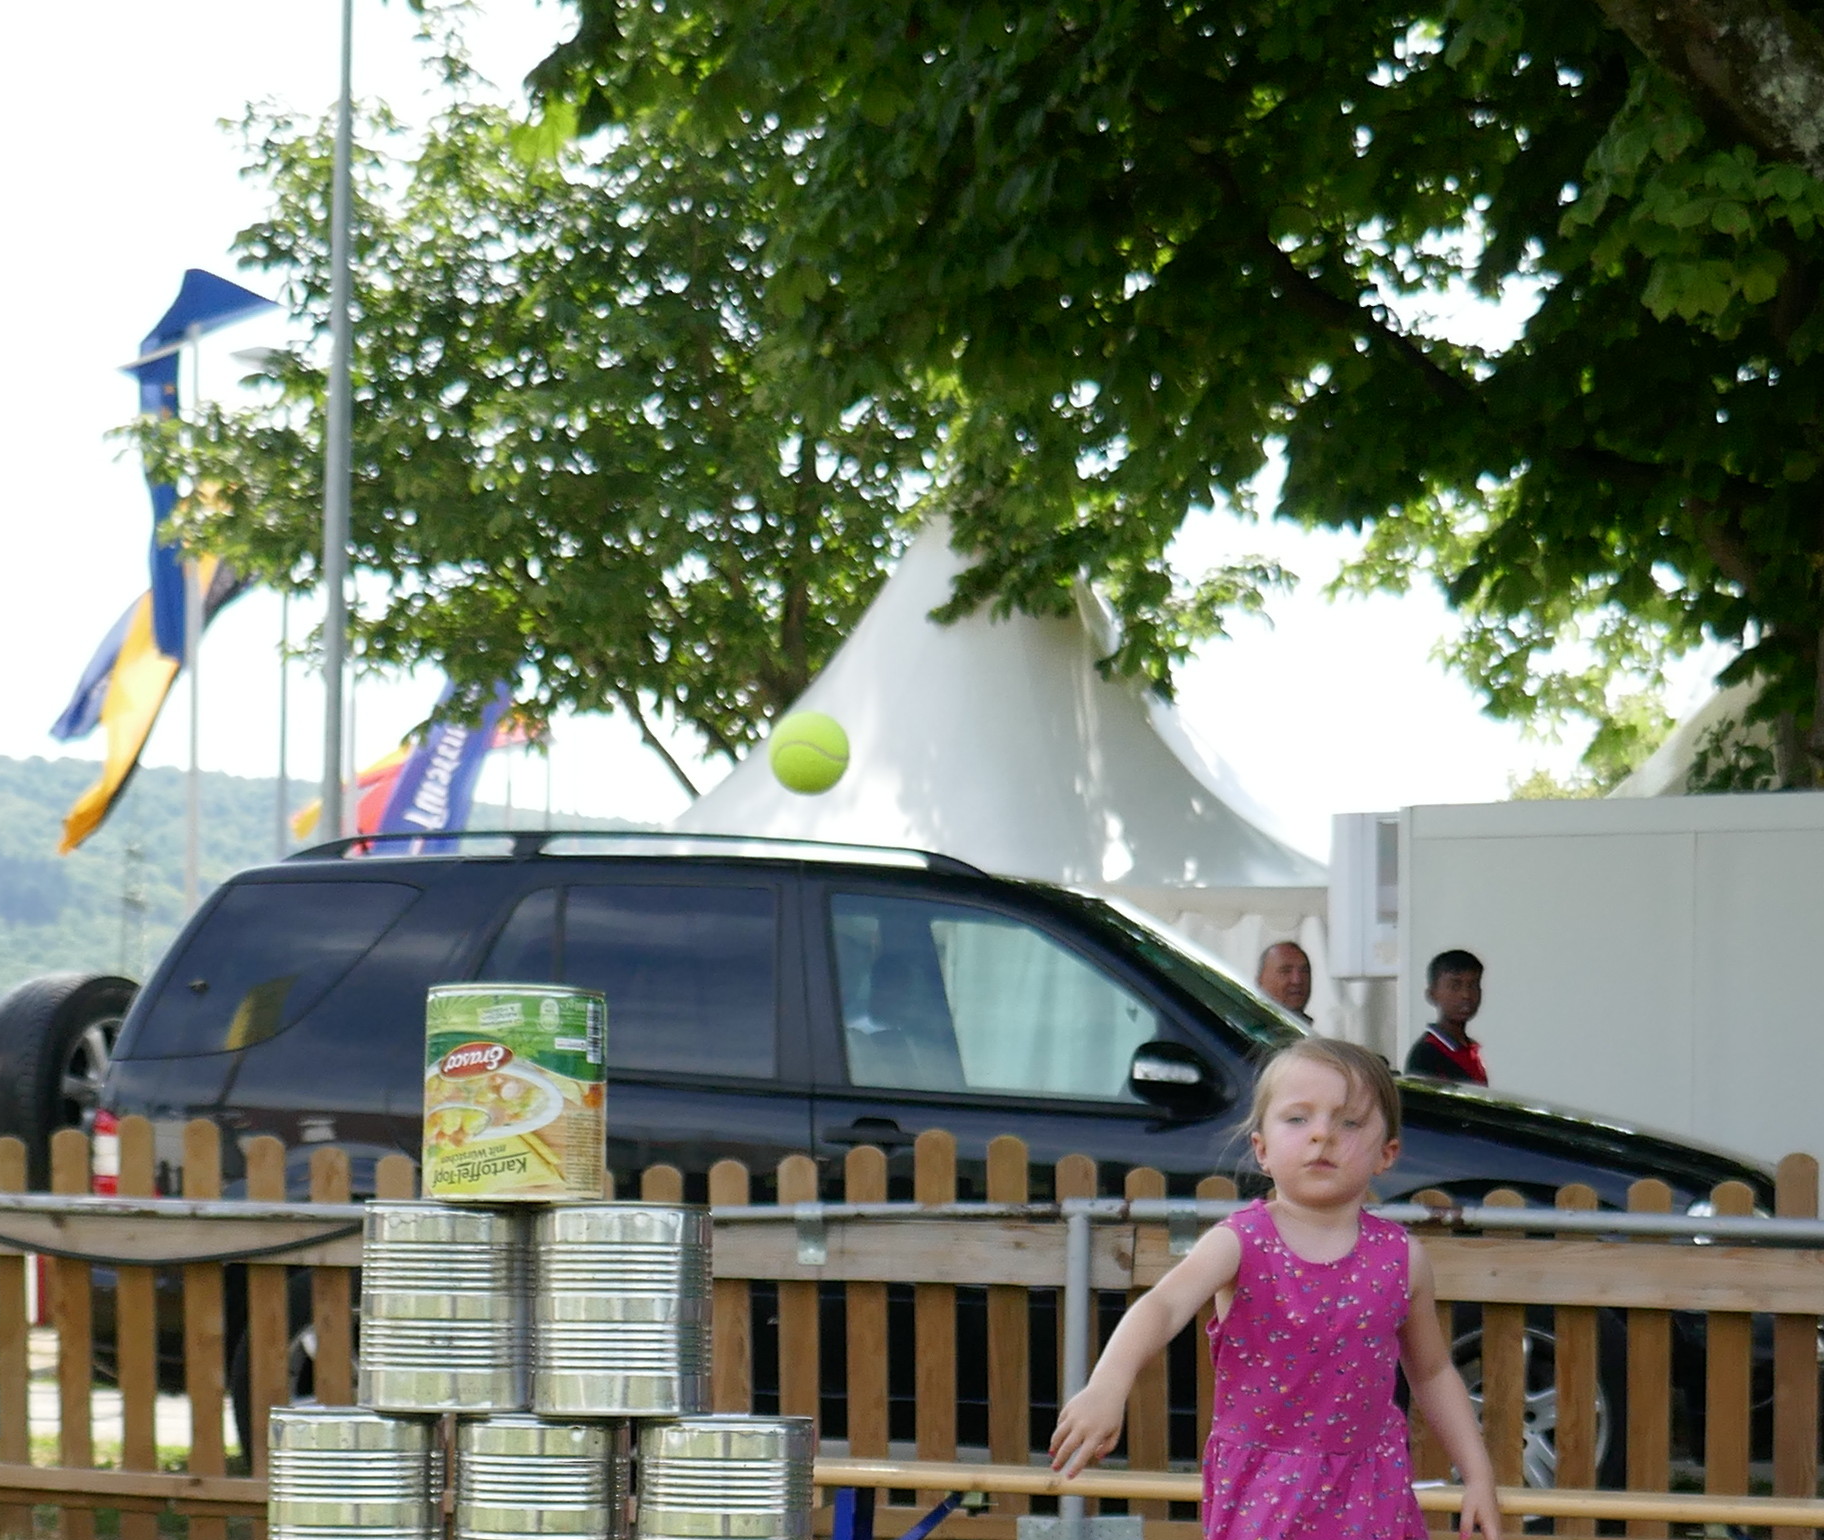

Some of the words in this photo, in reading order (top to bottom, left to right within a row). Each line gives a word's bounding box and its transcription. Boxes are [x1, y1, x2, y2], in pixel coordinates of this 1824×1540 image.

[444, 1046, 504, 1073] Erasco
[489, 1144, 506, 1155] mit
[432, 1157, 527, 1188] Kartoffel-Topf
